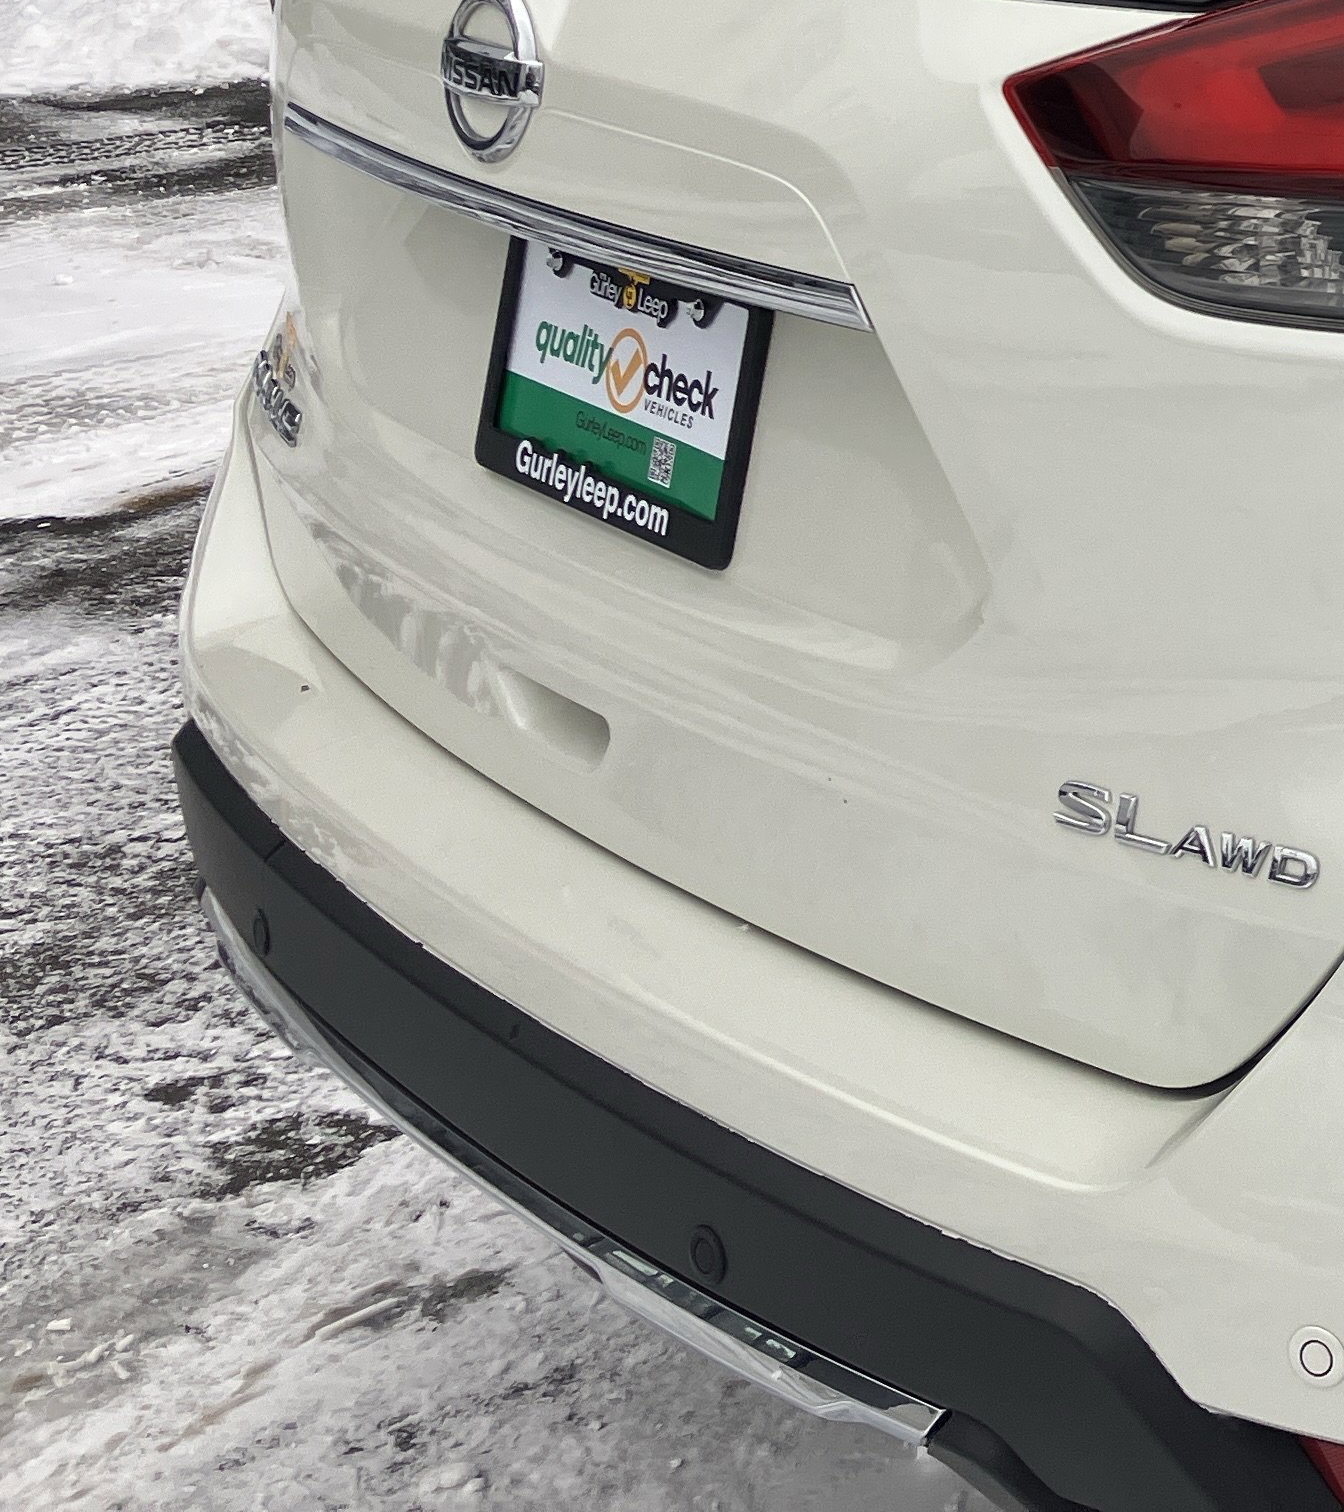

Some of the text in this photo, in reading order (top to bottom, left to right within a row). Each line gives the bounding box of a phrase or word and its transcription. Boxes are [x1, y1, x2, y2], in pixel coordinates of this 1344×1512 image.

[442, 50, 518, 99] NISSAN
[638, 287, 669, 325] Leep
[536, 320, 718, 419] quality check
[644, 398, 695, 430] VEHICLES
[515, 439, 669, 536] Gurleyleep.com
